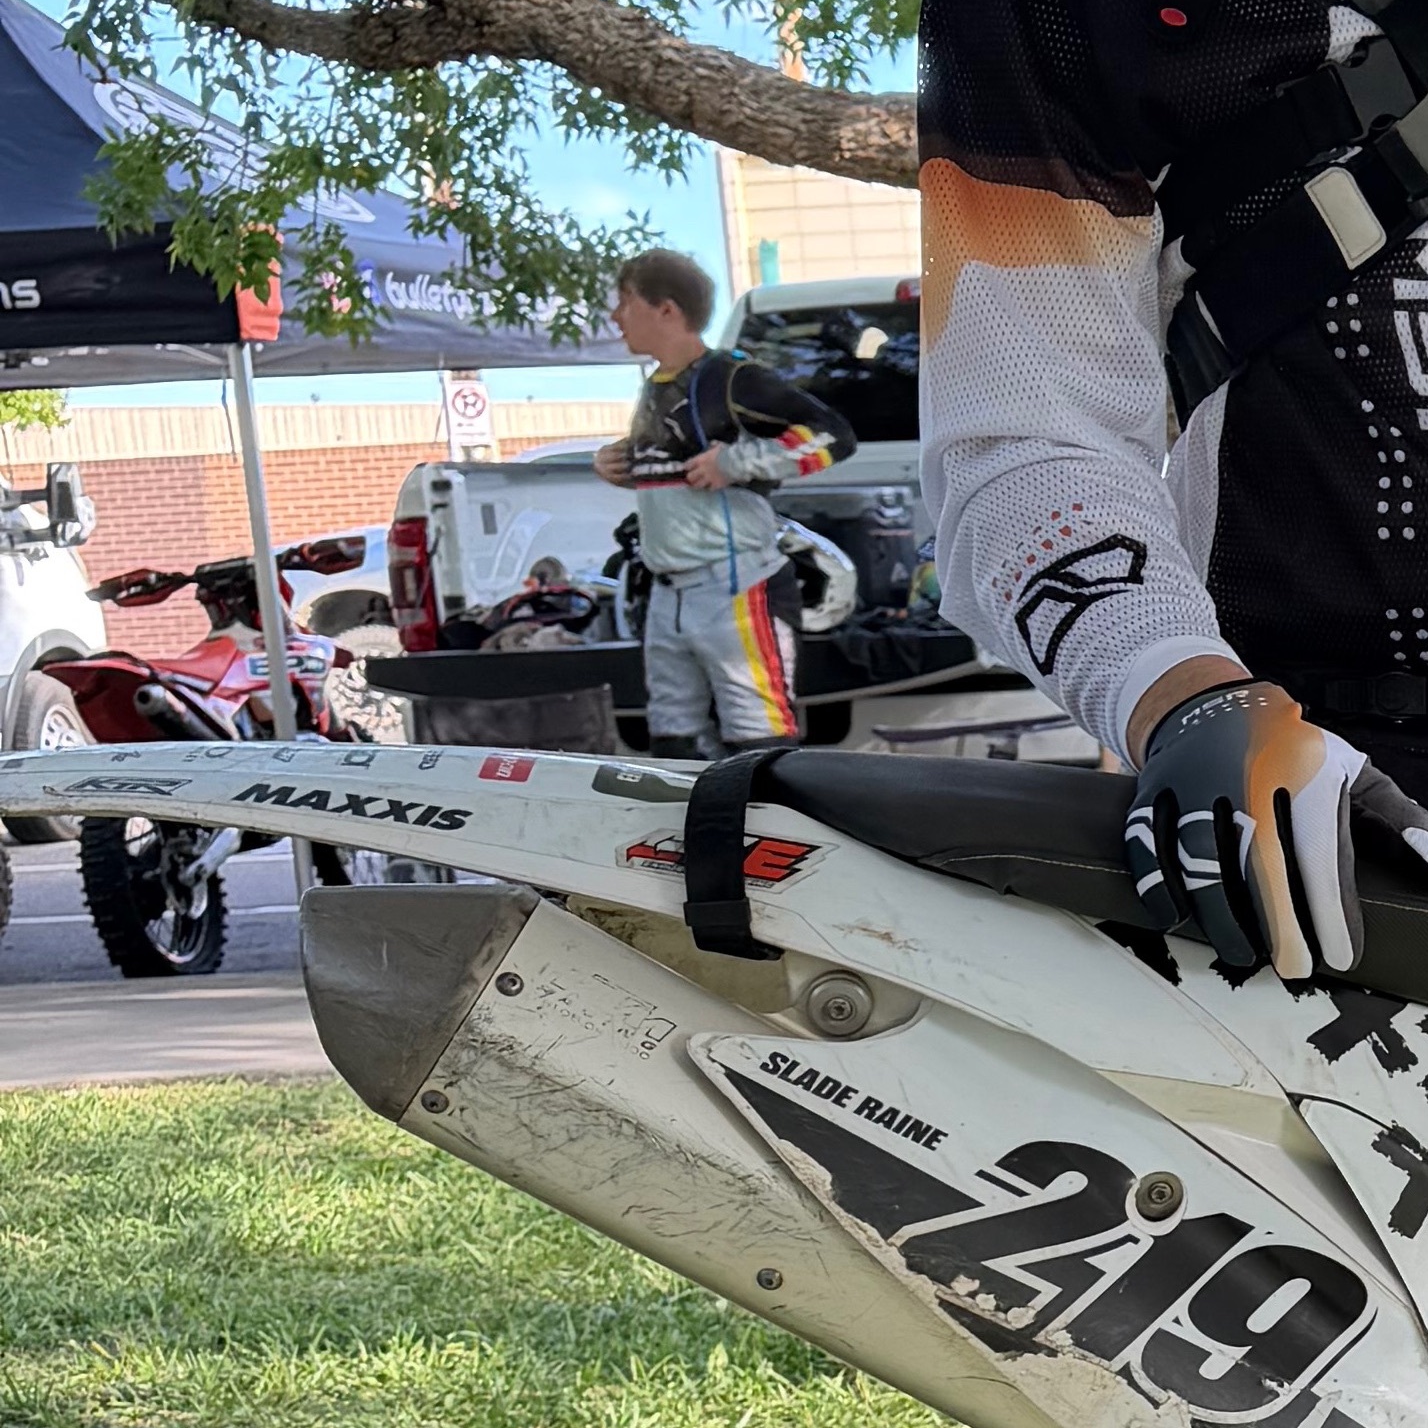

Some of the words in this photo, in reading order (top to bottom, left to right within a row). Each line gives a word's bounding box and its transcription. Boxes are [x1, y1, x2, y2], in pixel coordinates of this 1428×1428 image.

[232, 783, 474, 831] MAXXIS
[759, 1051, 858, 1114] SLADE
[853, 1094, 948, 1152] RAINE
[898, 1140, 1376, 1414] 219
